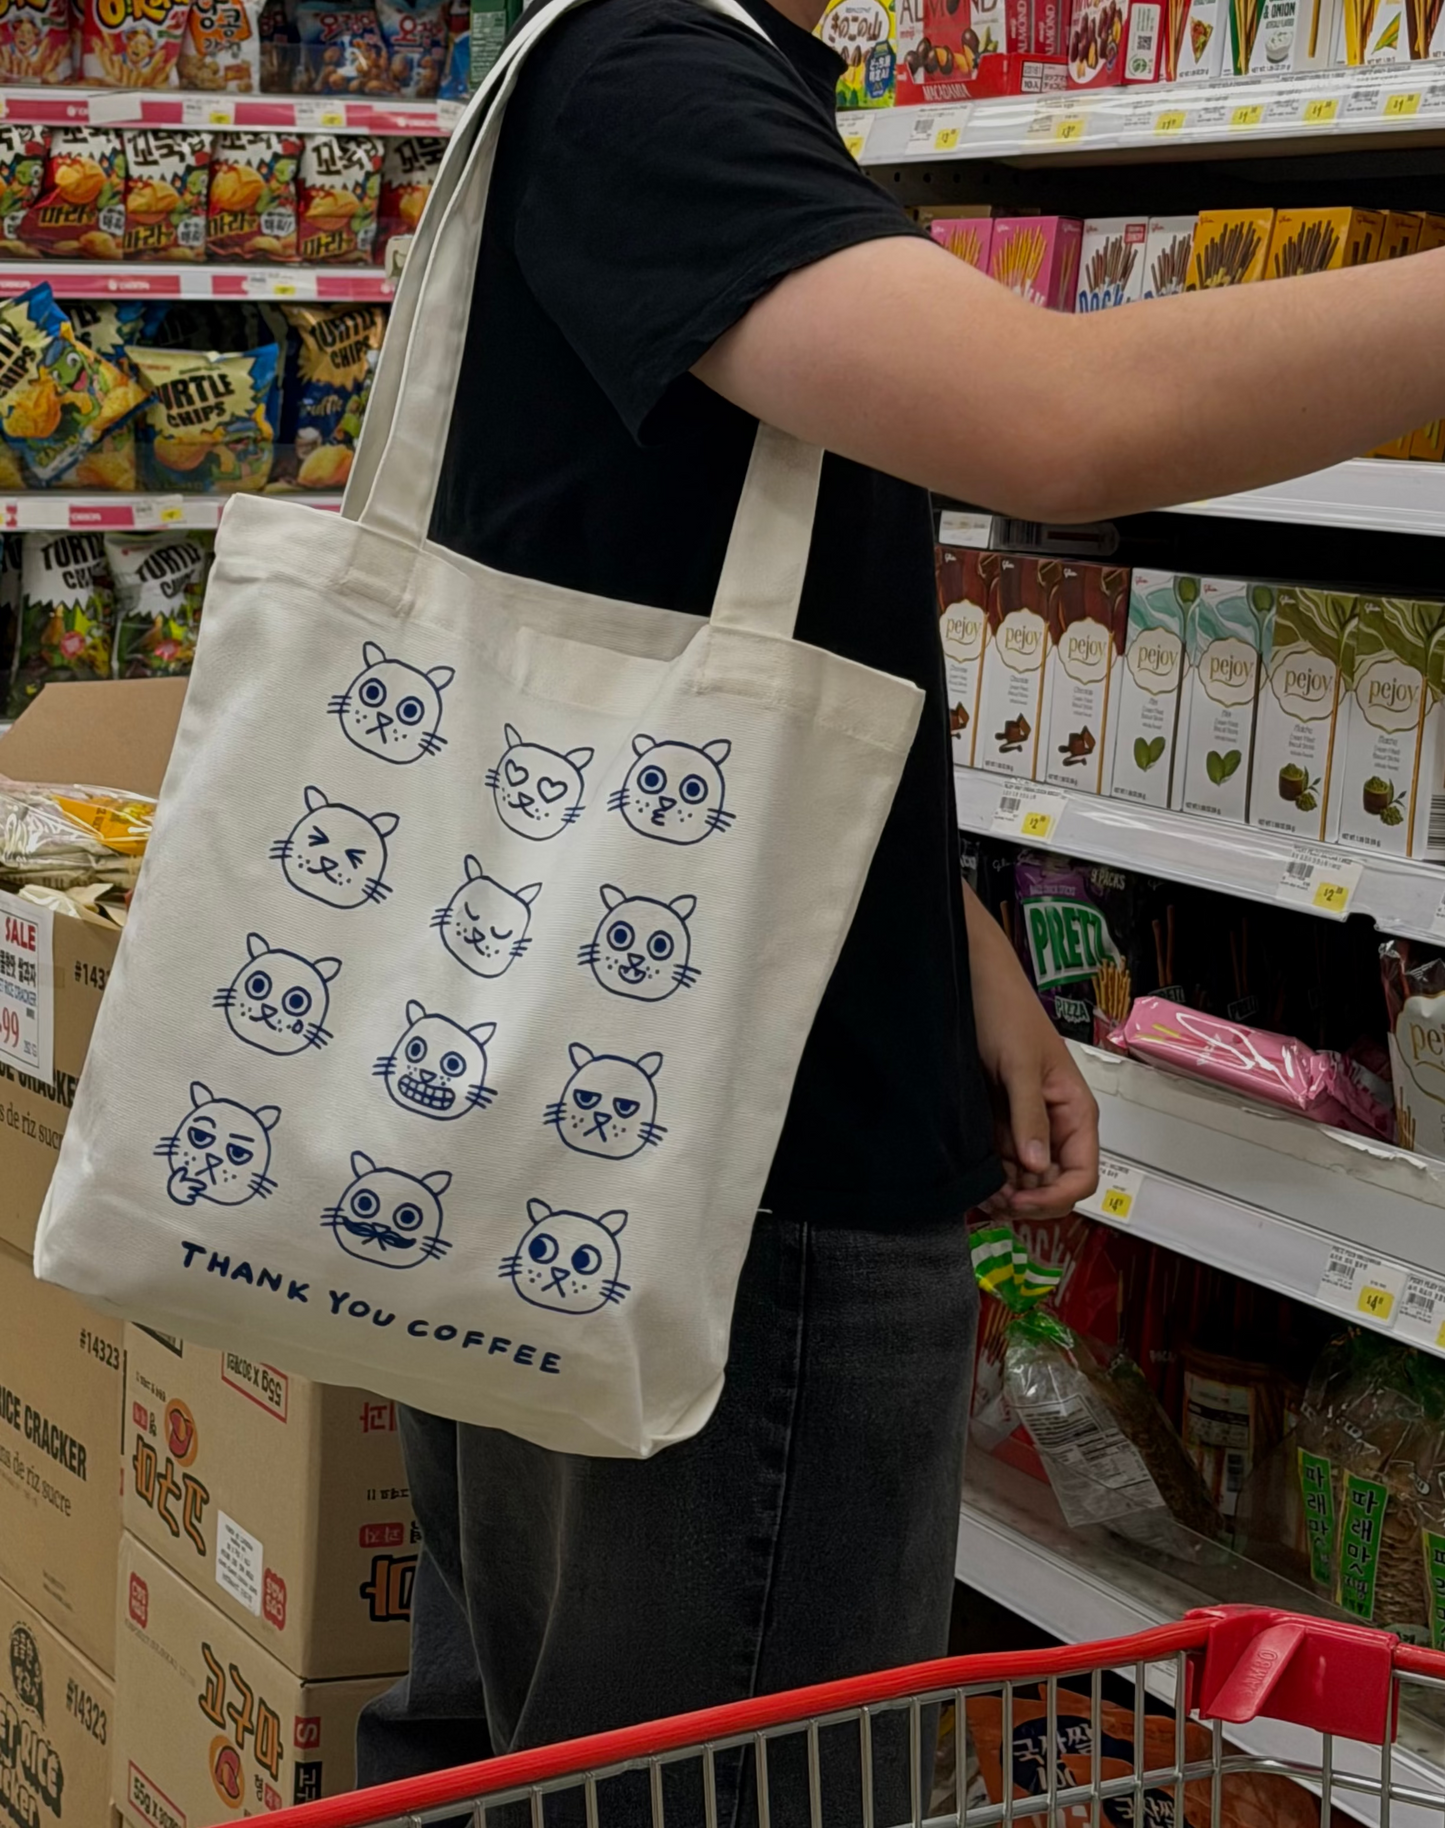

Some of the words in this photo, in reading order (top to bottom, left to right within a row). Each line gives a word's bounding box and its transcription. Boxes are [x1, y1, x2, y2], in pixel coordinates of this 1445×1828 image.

[1271, 2, 1296, 18] ONION
[167, 401, 226, 428] CHIPS
[946, 616, 981, 639] pejoy
[1005, 625, 1041, 648] pejoy
[1068, 634, 1106, 659] pejoy
[1137, 645, 1178, 669] pejoy
[1209, 655, 1253, 680] pejoy
[1284, 668, 1333, 693] pejoy
[1369, 678, 1419, 704] pejoy
[1098, 871, 1126, 890] PACKS
[5, 916, 36, 952] SALE
[74, 960, 109, 992] #143
[1056, 998, 1088, 1019] PIZZA
[7, 1101, 19, 1130] de
[21, 1110, 36, 1139] riz
[181, 1240, 311, 1304] THANK
[328, 1289, 396, 1328] YOU
[406, 1319, 562, 1376] COFFEE
[80, 1327, 120, 1371] #14323
[24, 1404, 87, 1482] CRACKER
[13, 1449, 25, 1482] de
[26, 1461, 41, 1496] riz
[1348, 1489, 1379, 1575] 파래맛
[66, 1676, 107, 1746] #14323
[199, 1641, 283, 1782] 고구마
[297, 1723, 318, 1744] S
[21, 1719, 60, 1795] RICE
